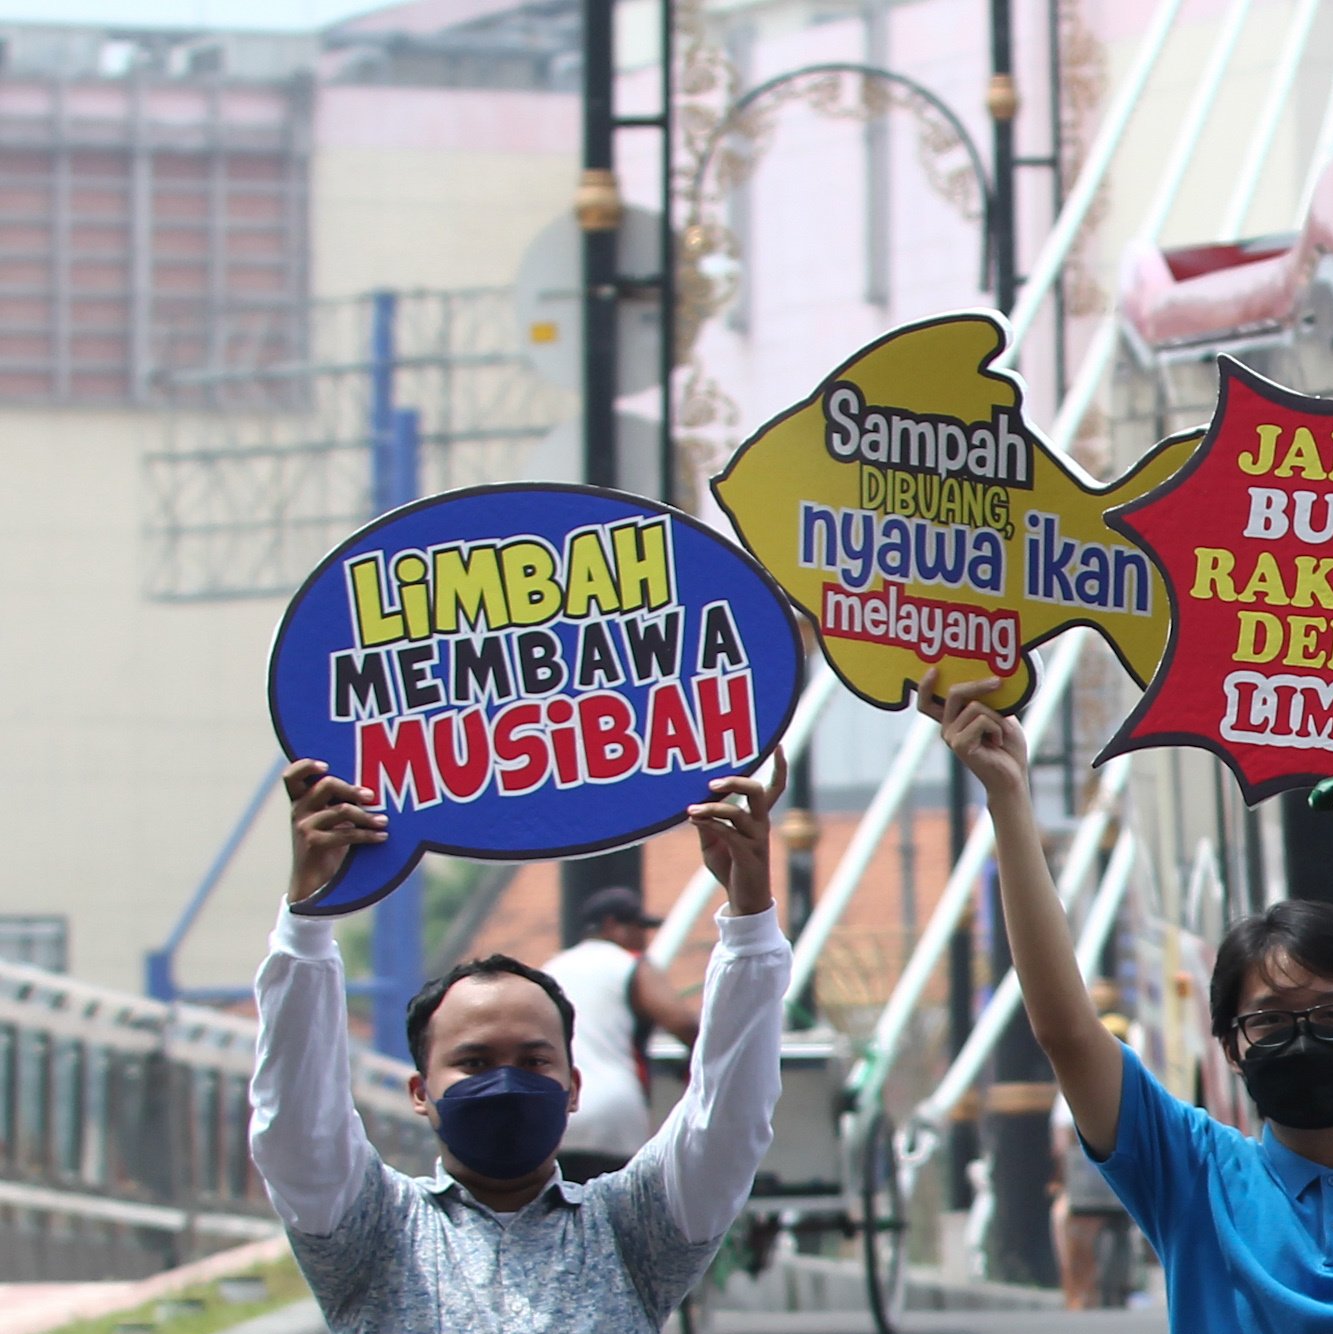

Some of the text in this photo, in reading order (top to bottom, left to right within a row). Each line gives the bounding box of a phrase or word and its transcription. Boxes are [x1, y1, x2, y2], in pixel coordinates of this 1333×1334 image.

[828, 386, 1028, 483] Sampah
[861, 464, 1015, 540] DIBUANG,
[801, 502, 1151, 613] nyawa ikan
[333, 602, 747, 719] MEMBAWA
[825, 585, 1018, 670] melayang
